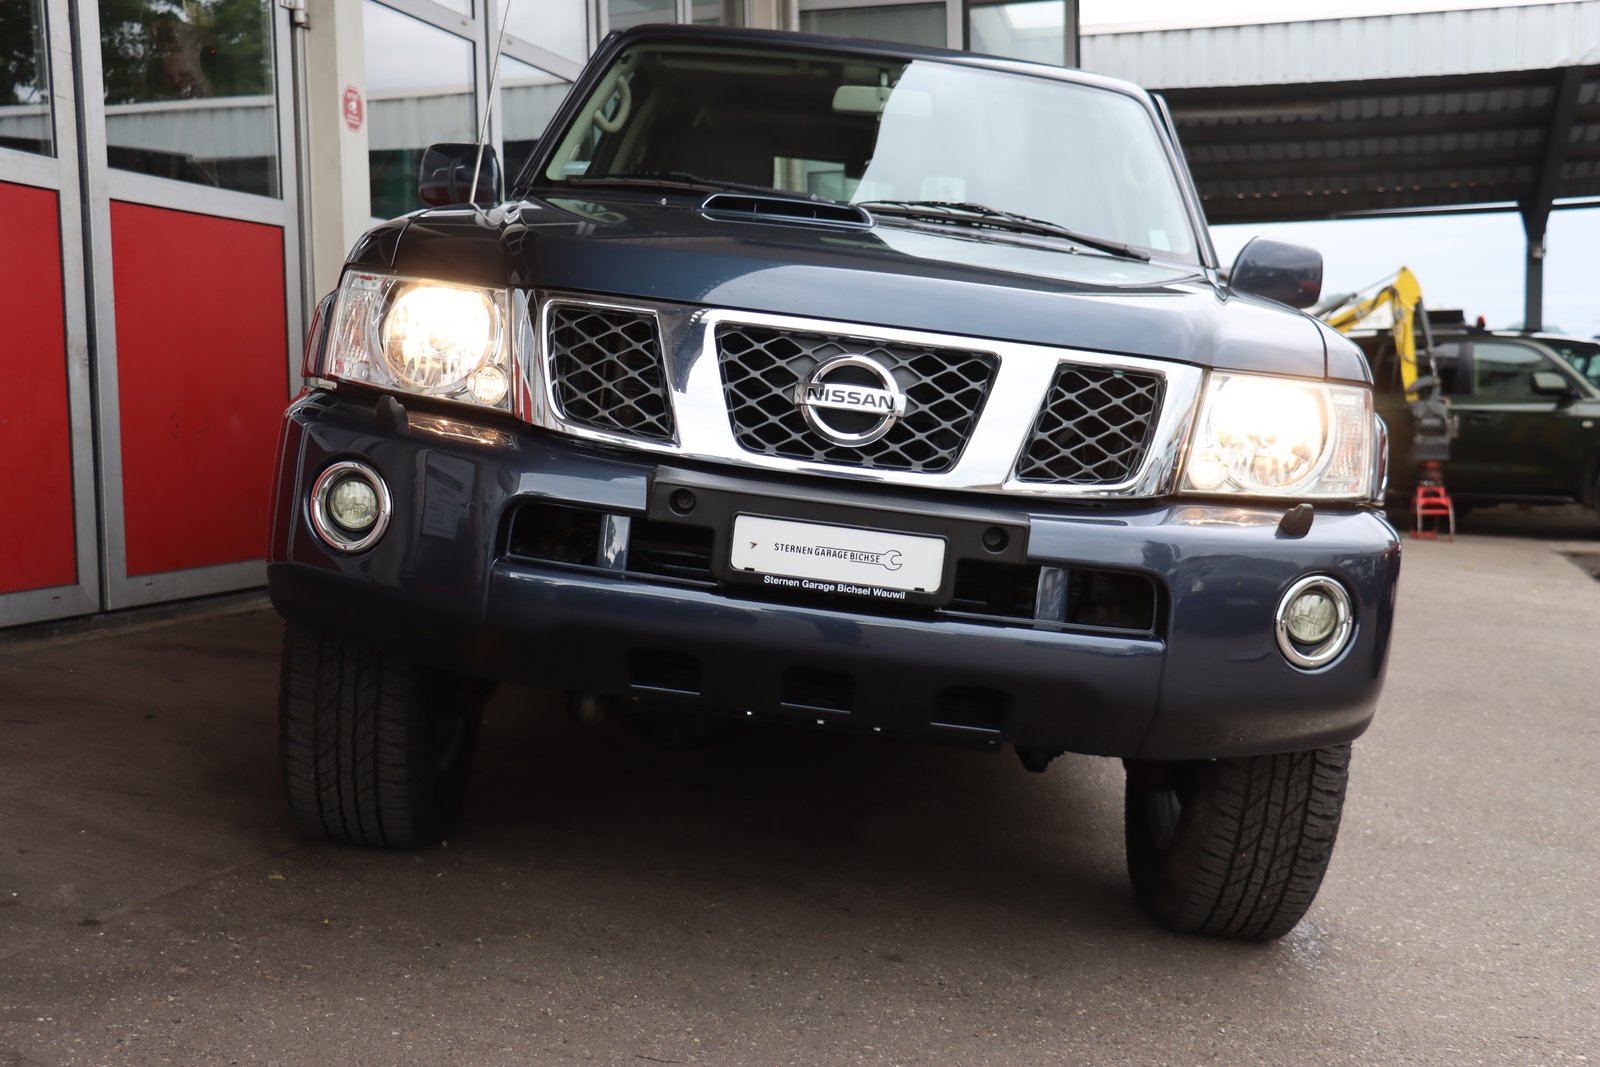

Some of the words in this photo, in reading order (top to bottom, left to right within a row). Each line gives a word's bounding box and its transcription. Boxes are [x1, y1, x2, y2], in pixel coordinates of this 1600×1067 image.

[806, 387, 895, 410] NISSAN
[774, 542, 813, 555] STERNEN
[814, 547, 849, 560] GARAGE
[763, 575, 800, 587] Sternen
[801, 579, 836, 593] Garage
[837, 583, 871, 595] Bichsel
[872, 587, 906, 600] Wauwil
